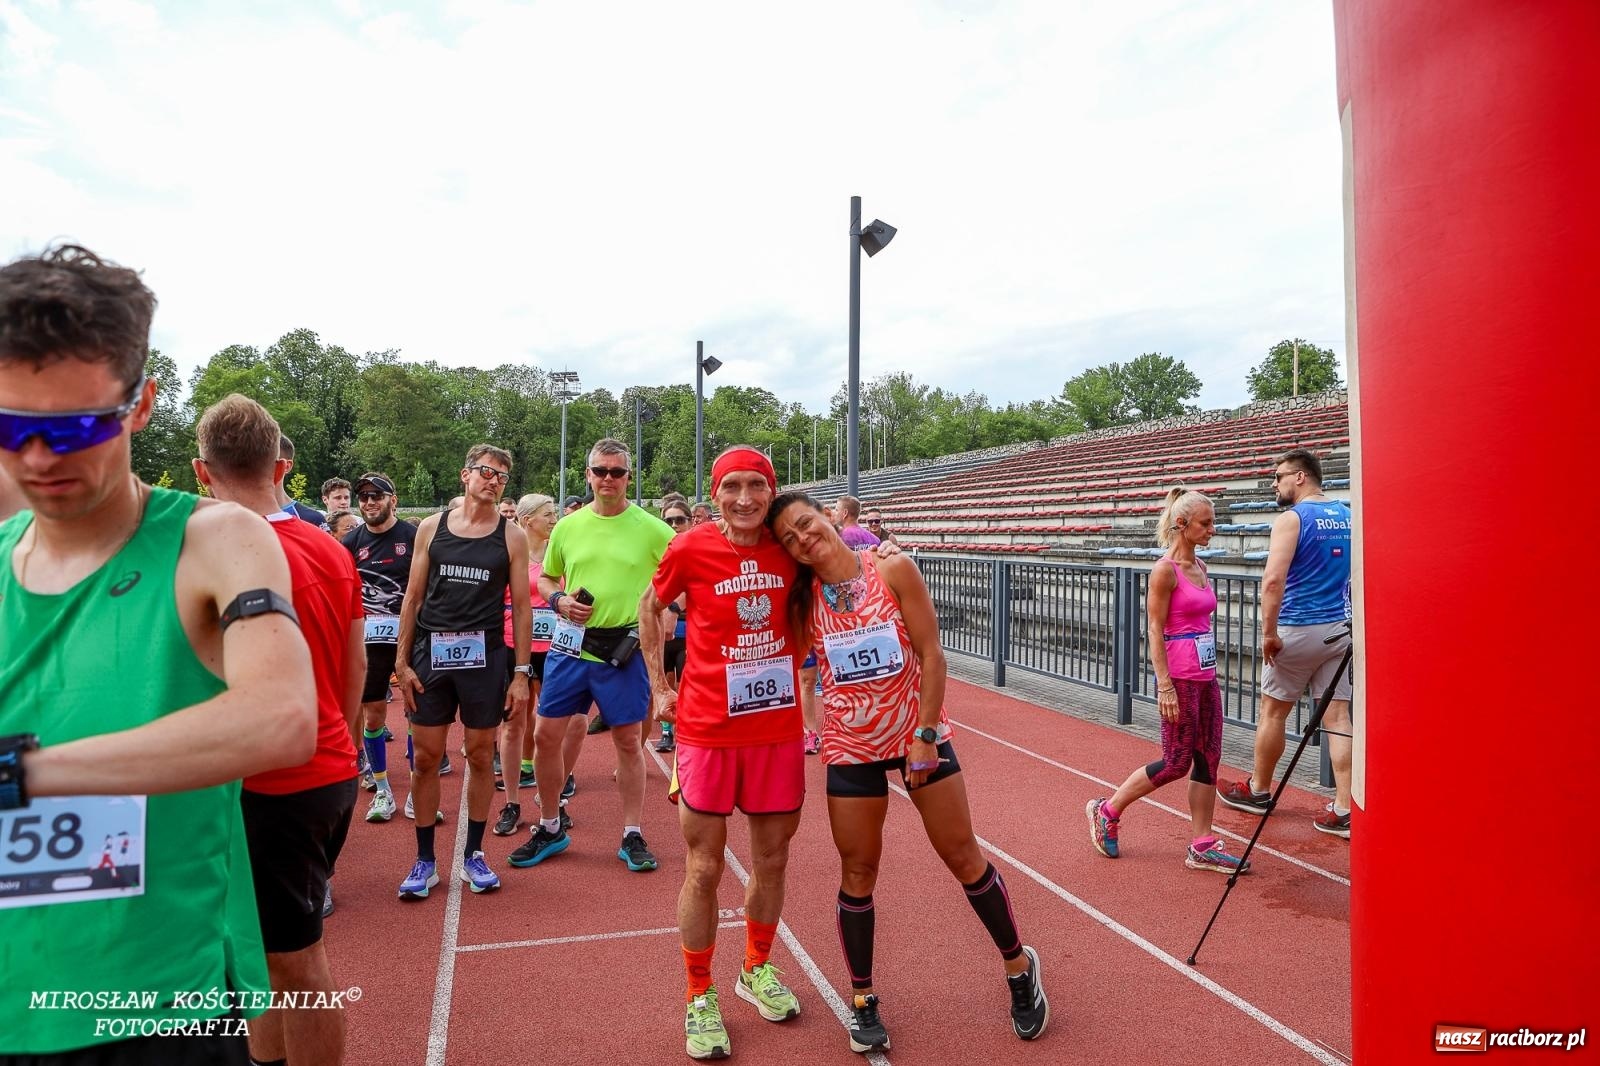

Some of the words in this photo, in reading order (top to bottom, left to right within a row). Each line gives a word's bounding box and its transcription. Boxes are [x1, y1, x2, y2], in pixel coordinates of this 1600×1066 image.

[440, 564, 490, 581] RUNNING
[740, 560, 758, 574] OD
[714, 573, 784, 595] URODZENIA
[374, 625, 394, 636] 172
[866, 623, 890, 633] GRANIC
[558, 632, 573, 646] 201
[737, 630, 774, 647] DUMNI
[445, 646, 471, 660] 187
[720, 645, 727, 657] Z
[729, 636, 786, 661] POCHODZENIA
[768, 657, 788, 665] GRANIC
[847, 647, 881, 669] 151
[745, 678, 777, 699] 168
